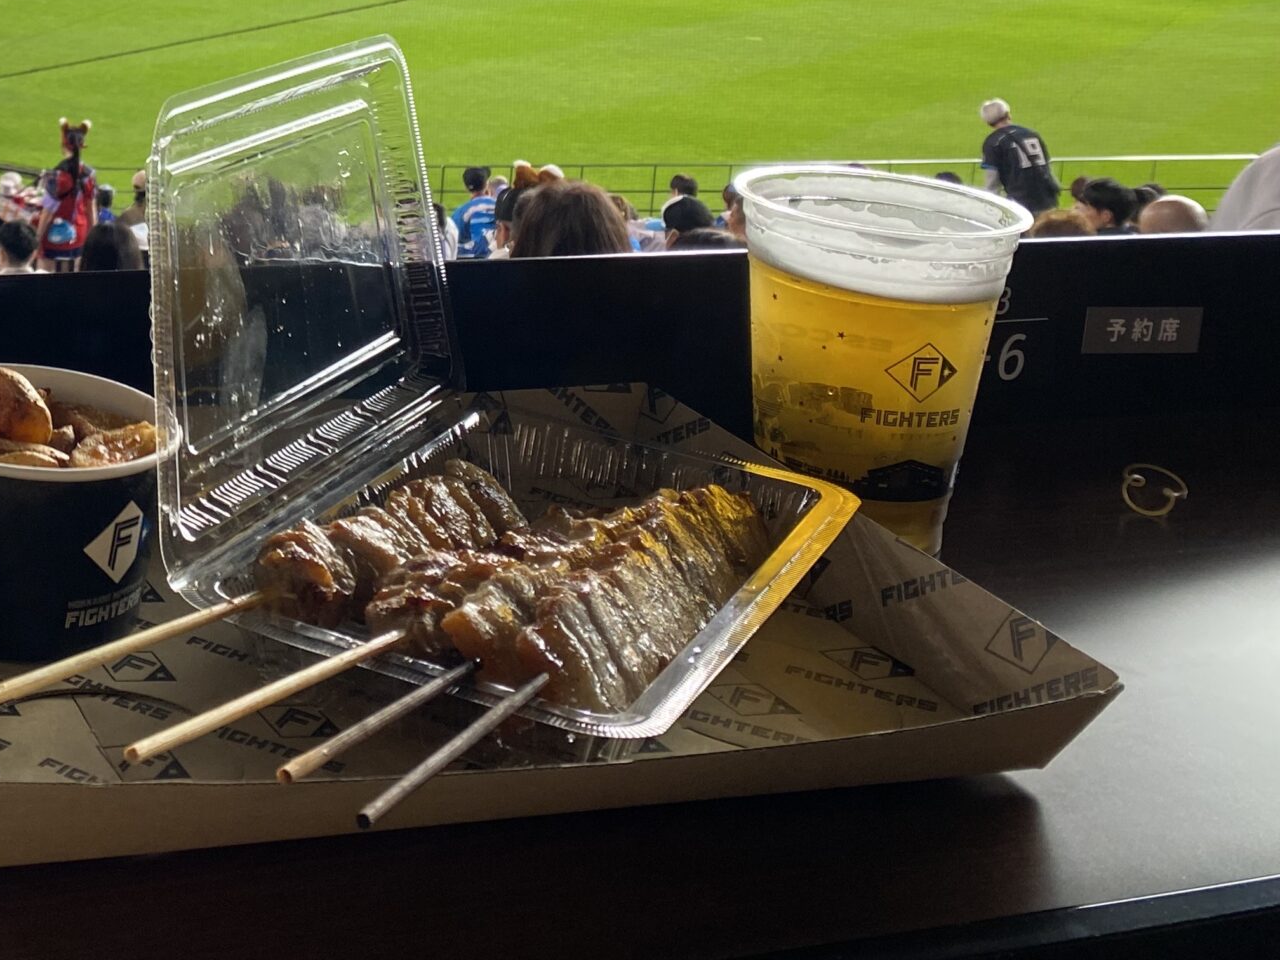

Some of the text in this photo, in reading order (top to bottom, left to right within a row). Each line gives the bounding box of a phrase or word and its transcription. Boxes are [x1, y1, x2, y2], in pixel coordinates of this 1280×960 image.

[1011, 137, 1046, 169] 19
[1106, 317, 1181, 343] 予約席
[860, 408, 960, 429] FIGHTERS
[785, 664, 938, 712] FIGHTERS
